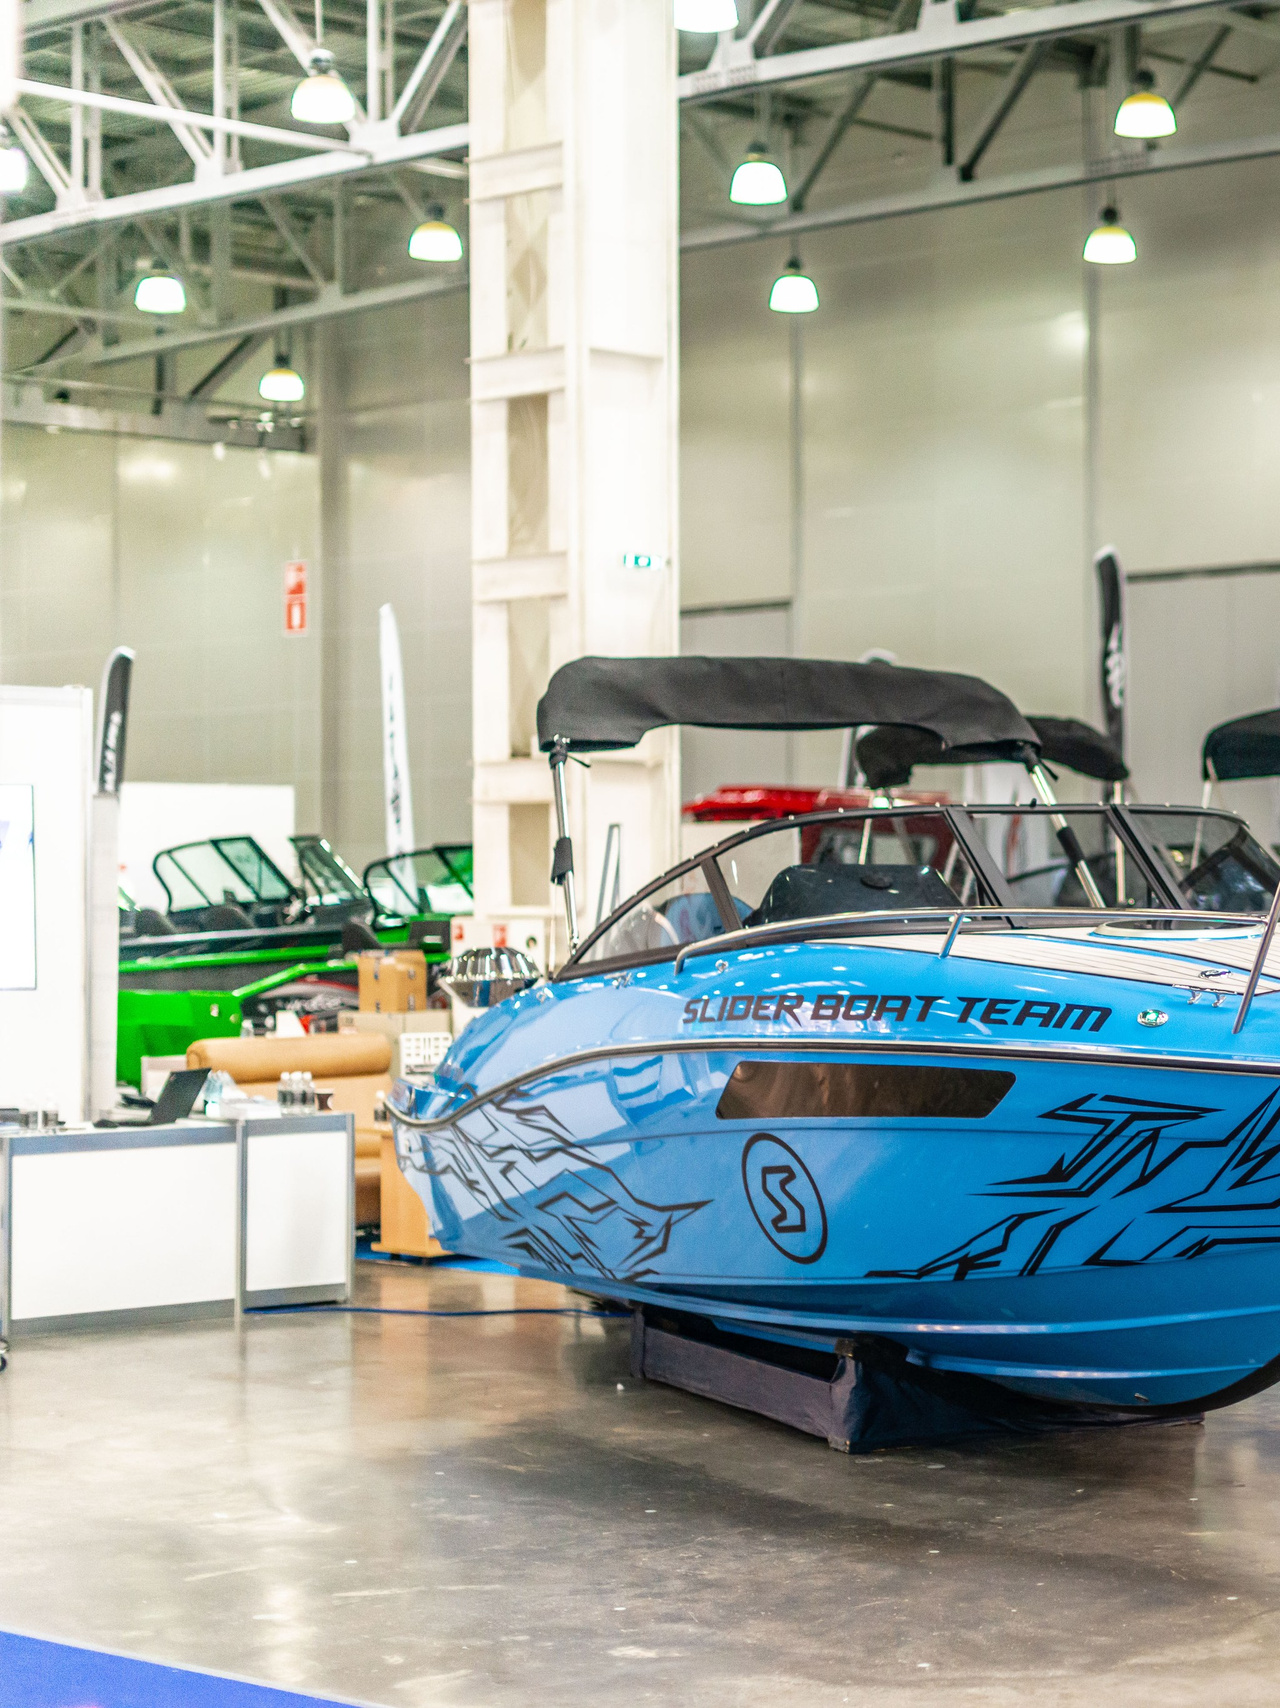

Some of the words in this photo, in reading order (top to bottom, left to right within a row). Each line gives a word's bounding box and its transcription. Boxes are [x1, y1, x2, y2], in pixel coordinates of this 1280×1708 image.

[683, 994, 804, 1027] SLIDER
[810, 994, 945, 1022] BOAT
[956, 996, 1113, 1032] TEAM
